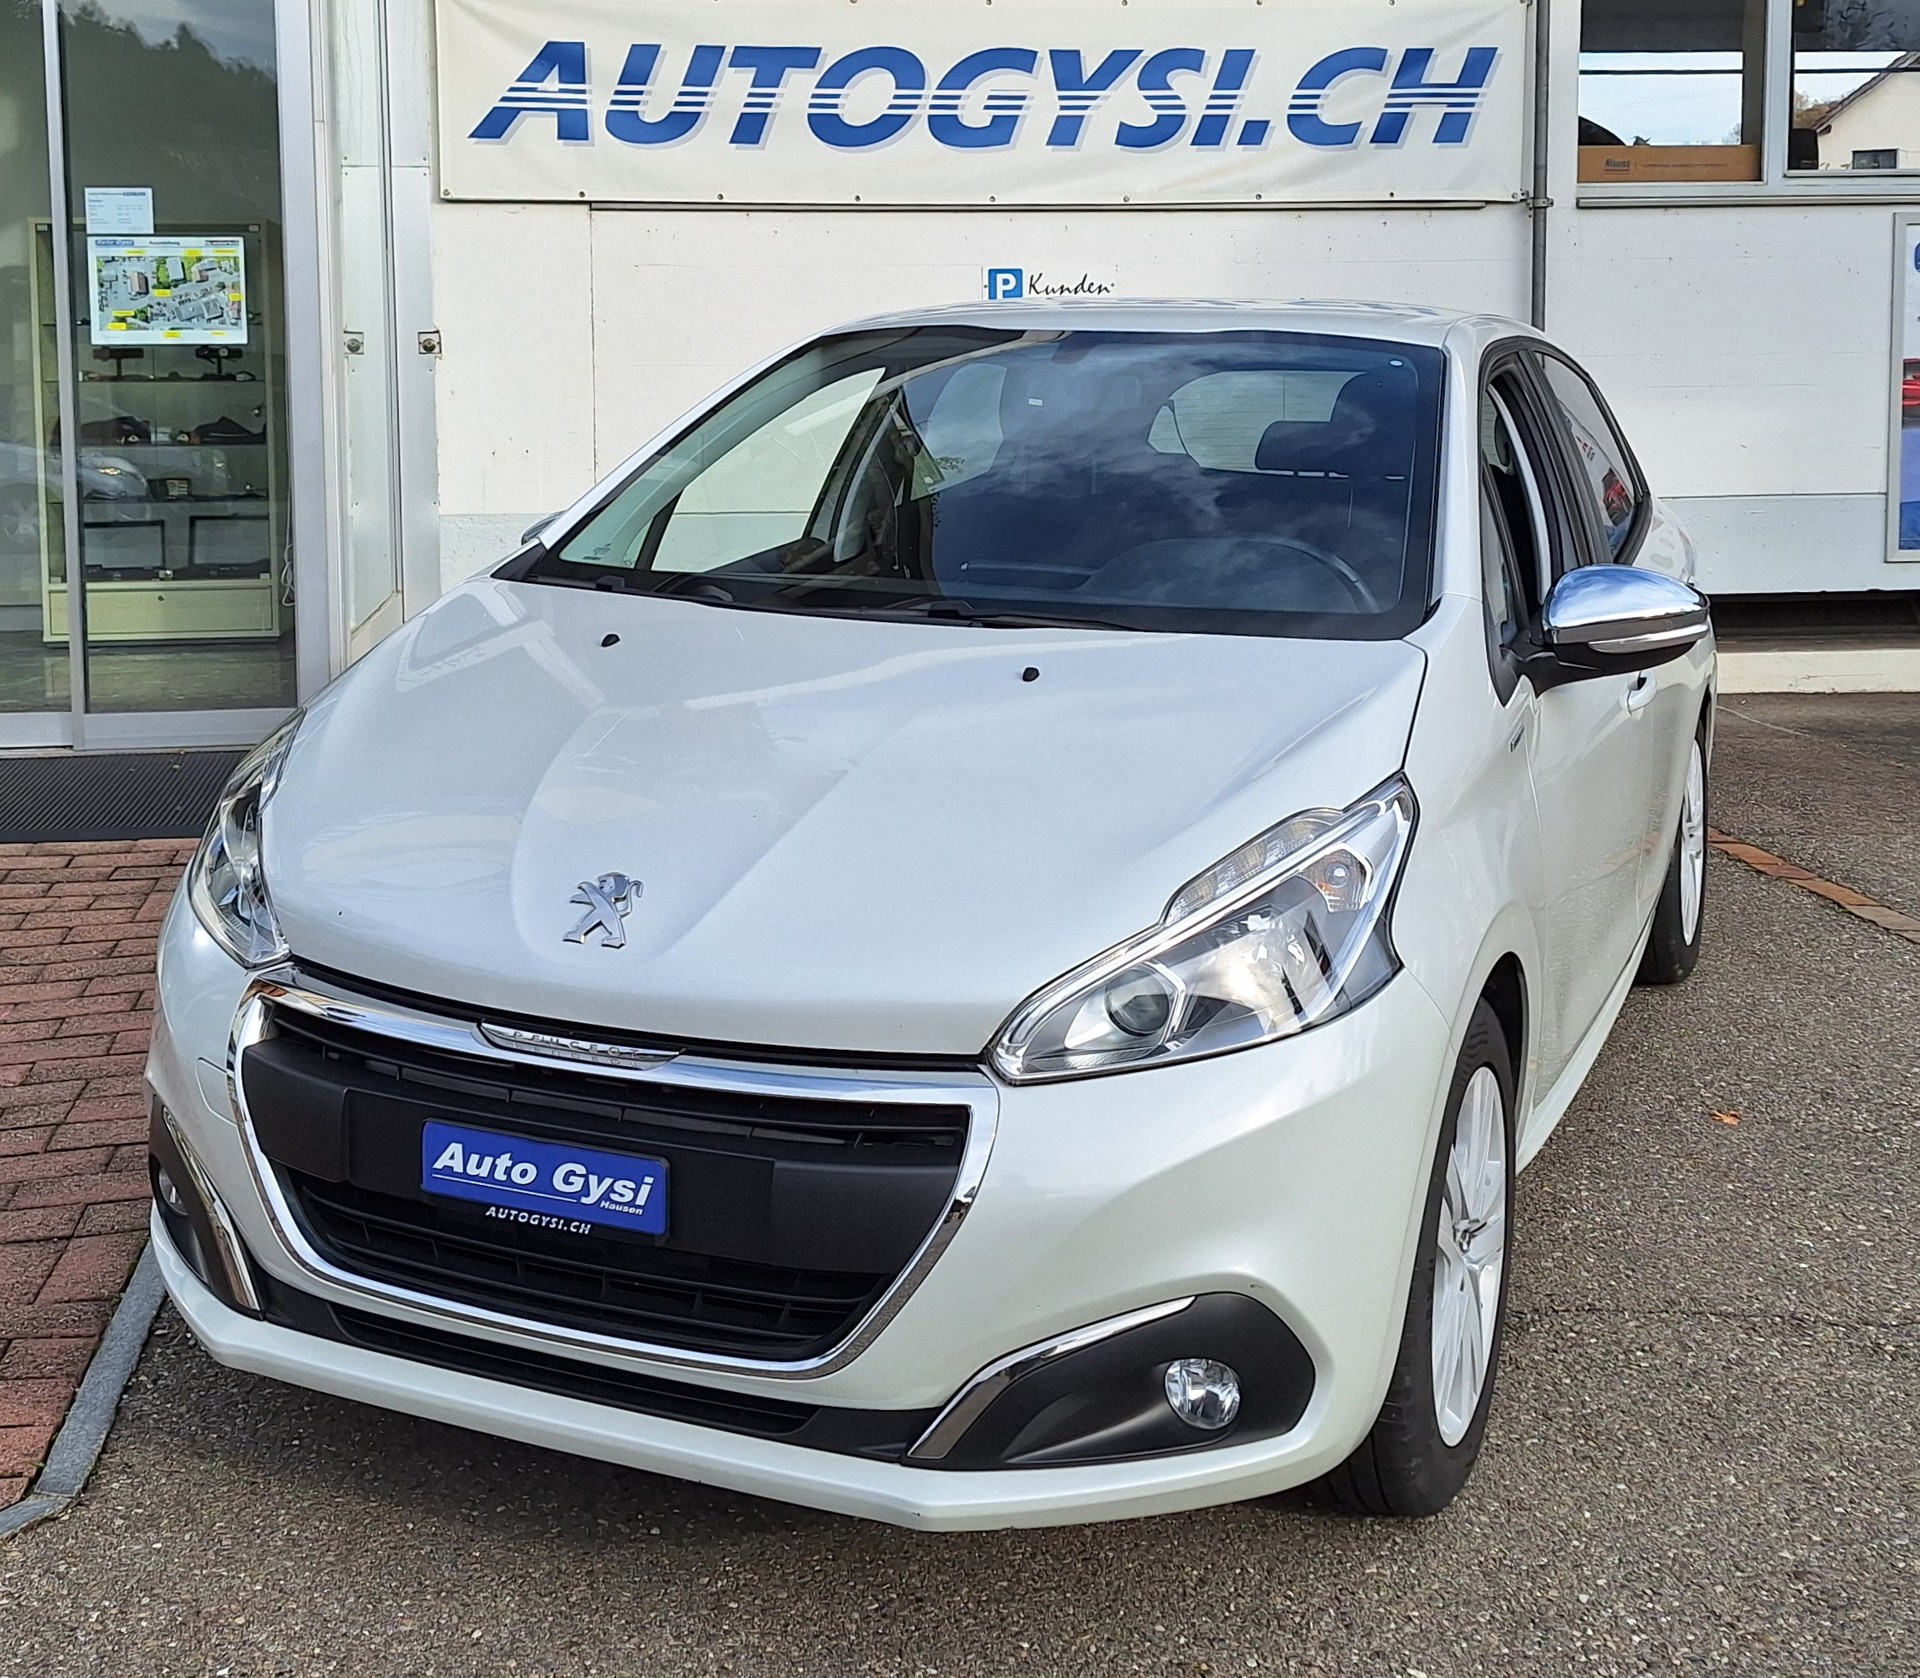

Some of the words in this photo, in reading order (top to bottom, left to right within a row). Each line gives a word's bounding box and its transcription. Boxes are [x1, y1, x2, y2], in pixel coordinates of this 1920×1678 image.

[467, 40, 1500, 149] AUTOGYSI.CH
[994, 271, 1019, 300] P
[1028, 272, 1111, 296] Kunden
[432, 1142, 538, 1185] Auto
[552, 1162, 654, 1206] Gysi
[485, 1206, 592, 1235] AUTOGYSI.CH
[600, 1200, 644, 1216] Hausen
